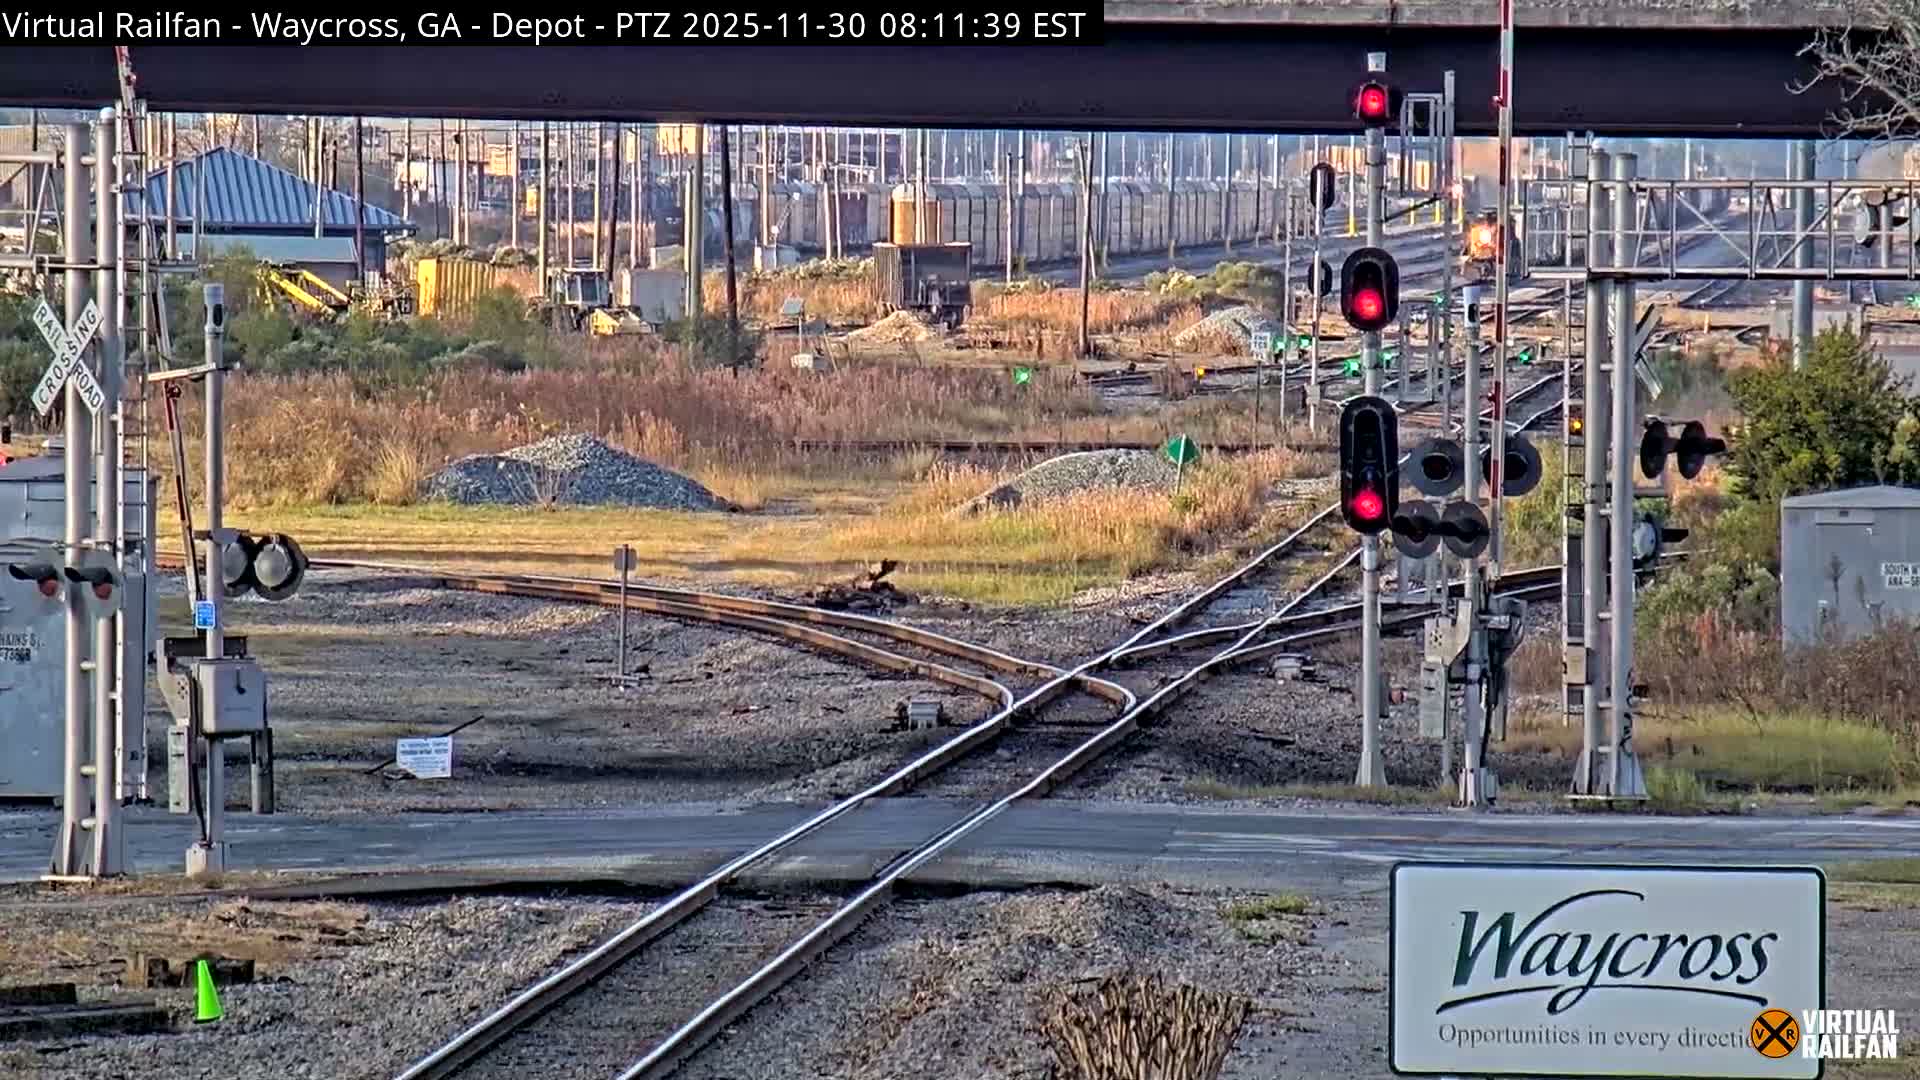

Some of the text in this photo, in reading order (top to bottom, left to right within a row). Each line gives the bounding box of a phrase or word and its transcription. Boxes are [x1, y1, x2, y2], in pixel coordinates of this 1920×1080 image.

[36, 306, 101, 408] RAIL ROAD
[38, 309, 97, 405] CROSSING
[1452, 889, 1779, 1016] Waycross
[1438, 1023, 1581, 1048] Opportunities
[1588, 1024, 1608, 1045] in
[1614, 1032, 1670, 1050] every
